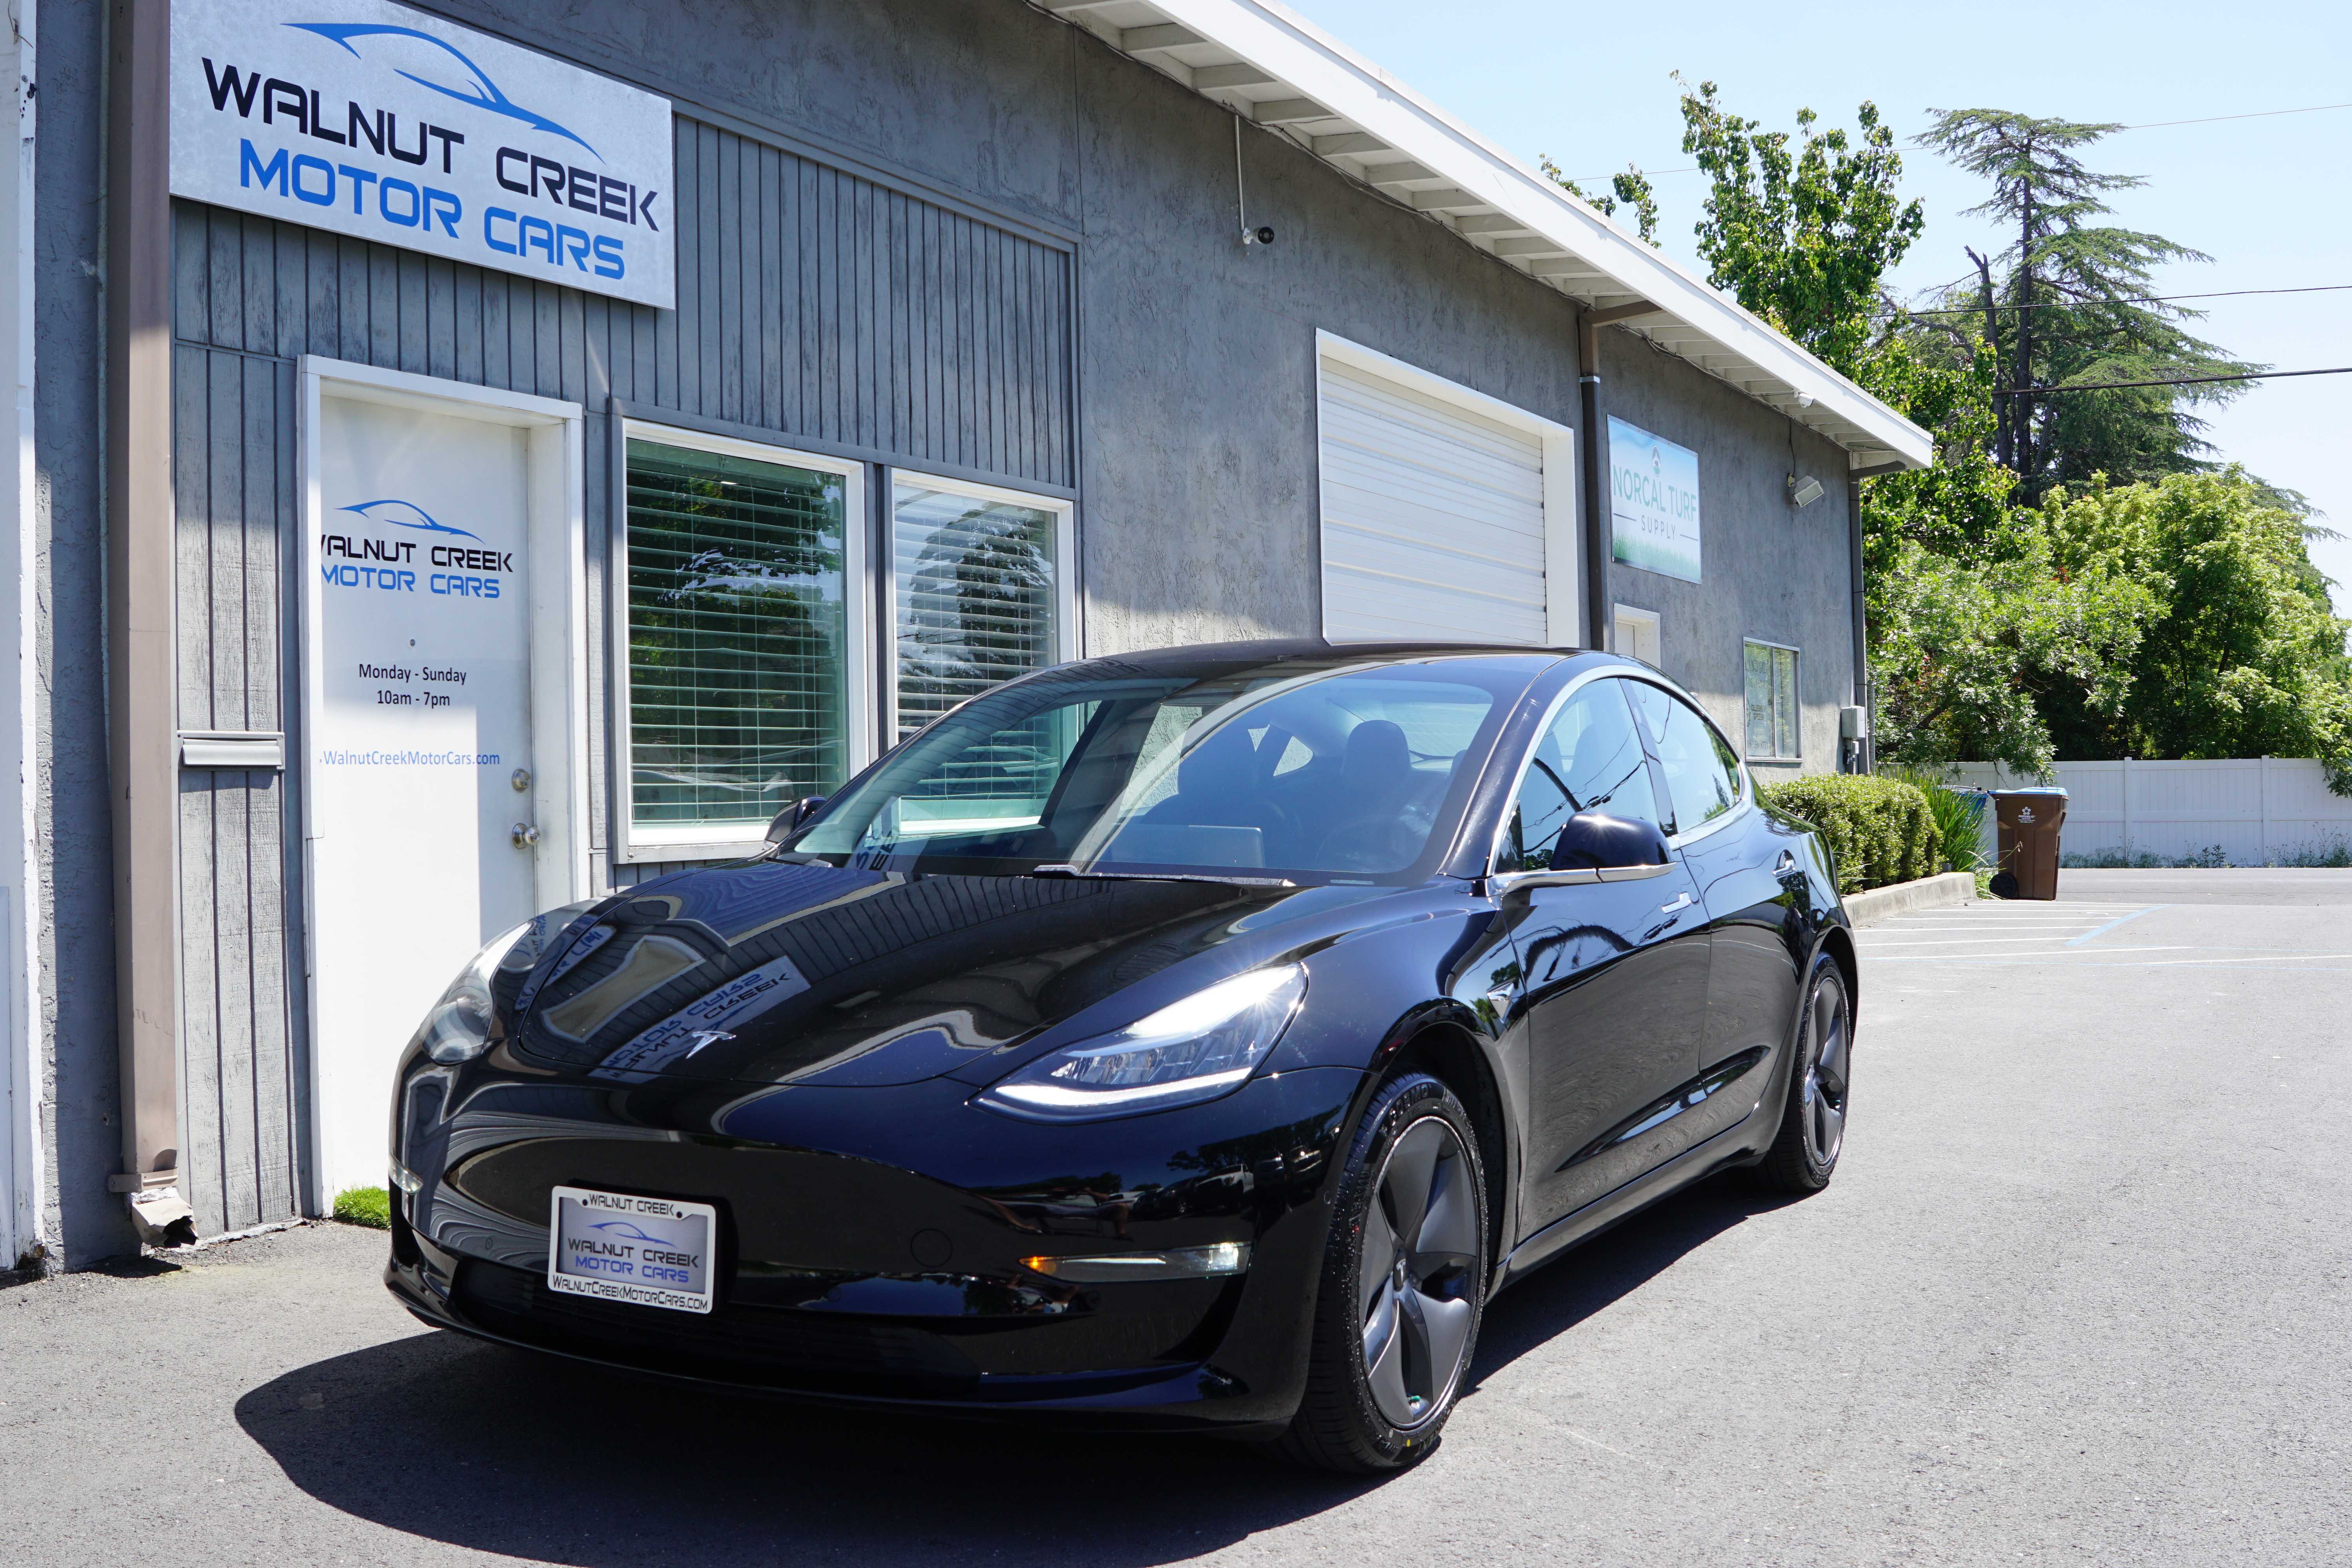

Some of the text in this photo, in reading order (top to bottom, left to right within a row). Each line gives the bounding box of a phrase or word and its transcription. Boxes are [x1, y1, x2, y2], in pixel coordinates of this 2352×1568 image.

[201, 57, 659, 232] WALNUT CREEK
[240, 138, 626, 280] MOTOR CARS
[1613, 465, 1697, 523] NORCAL TURF
[1642, 515, 1675, 541] SUPPLY
[321, 534, 513, 572] ALNUT CREEK
[321, 563, 500, 599] MOTOR CARS
[359, 664, 411, 683] Monday
[423, 667, 467, 686] Sunday
[377, 690, 411, 705] 10am
[423, 691, 450, 709] 7pm
[589, 1194, 674, 1216] WALNUT CREEK
[568, 1238, 699, 1268] WALNUT CREEK
[575, 1255, 688, 1283] MOTOR CARS
